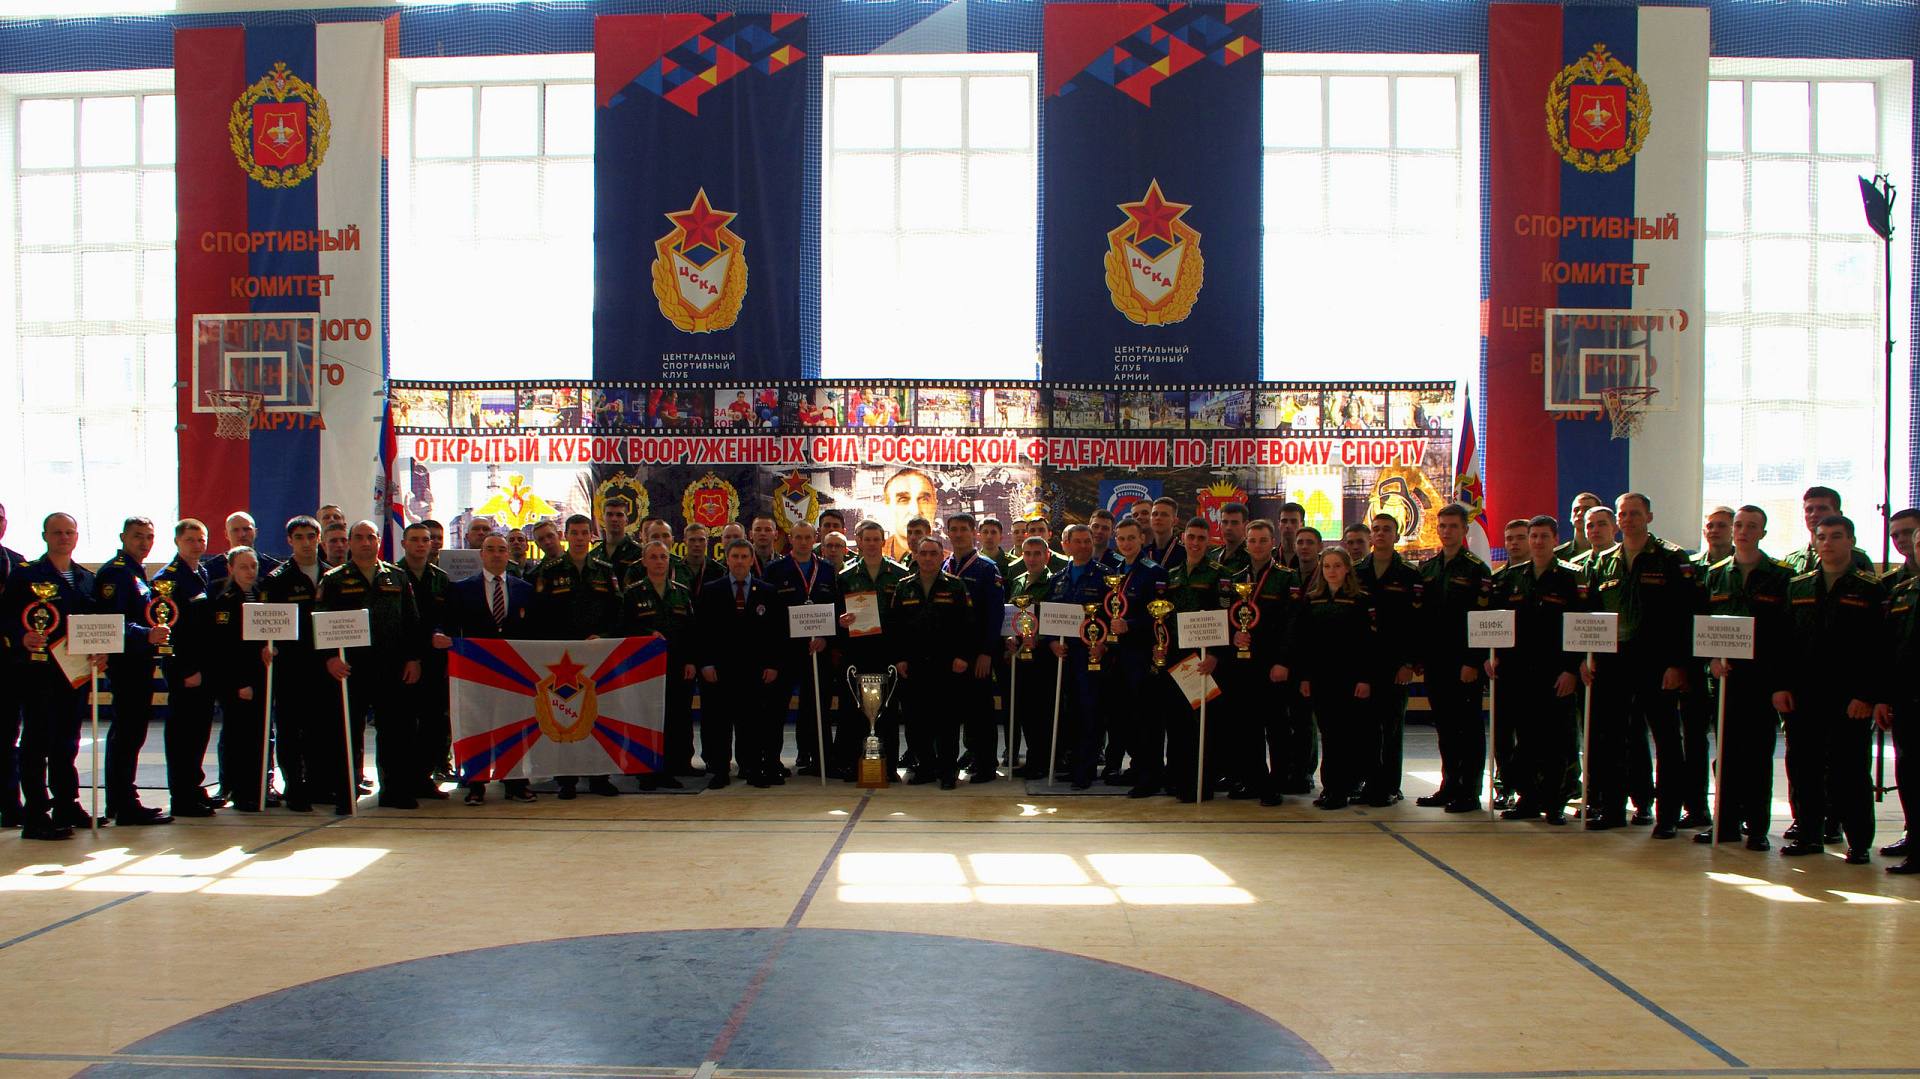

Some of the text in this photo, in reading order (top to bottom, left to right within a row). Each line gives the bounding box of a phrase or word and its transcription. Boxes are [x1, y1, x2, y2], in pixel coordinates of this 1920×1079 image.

[1515, 213, 1678, 240] СПОРТИВНЫЙ
[201, 224, 360, 252] СПОРТИВНЫЙ
[1132, 258, 1172, 287] ЦСКА
[1541, 262, 1649, 286] КОМИТЕТ
[679, 267, 719, 294] ЦСКА
[230, 274, 334, 298] КОМИТЕТ
[1114, 345, 1189, 354] ЦЕНТРАЛЬНЫЙ
[662, 352, 736, 361] ЦЕНТРАЛЬНЫЙ
[1114, 354, 1184, 363] СПОРТИВНЫЙ
[662, 361, 730, 370] СПОРТИВНЫЙ
[1114, 364, 1141, 372] КЛУБ
[662, 371, 688, 379] КЛУБ
[1114, 373, 1150, 381] АРМИИ
[415, 432, 1425, 469] ОТКРЫТЫЙ КУБОК ВООРУЖЕННЫХ СИЛ РОССИЙСКОЙ ФЕДЕРАЦИИ ПО ГИРЕВОМУ СПОРТУ
[785, 501, 803, 519] ЦСКА
[792, 612, 832, 620] ЦЕНТРАЛЬНЫЙ
[252, 618, 290, 626] МОРСКОЙ
[1480, 620, 1504, 628] ВИФК
[552, 700, 578, 719] ЦСКА
